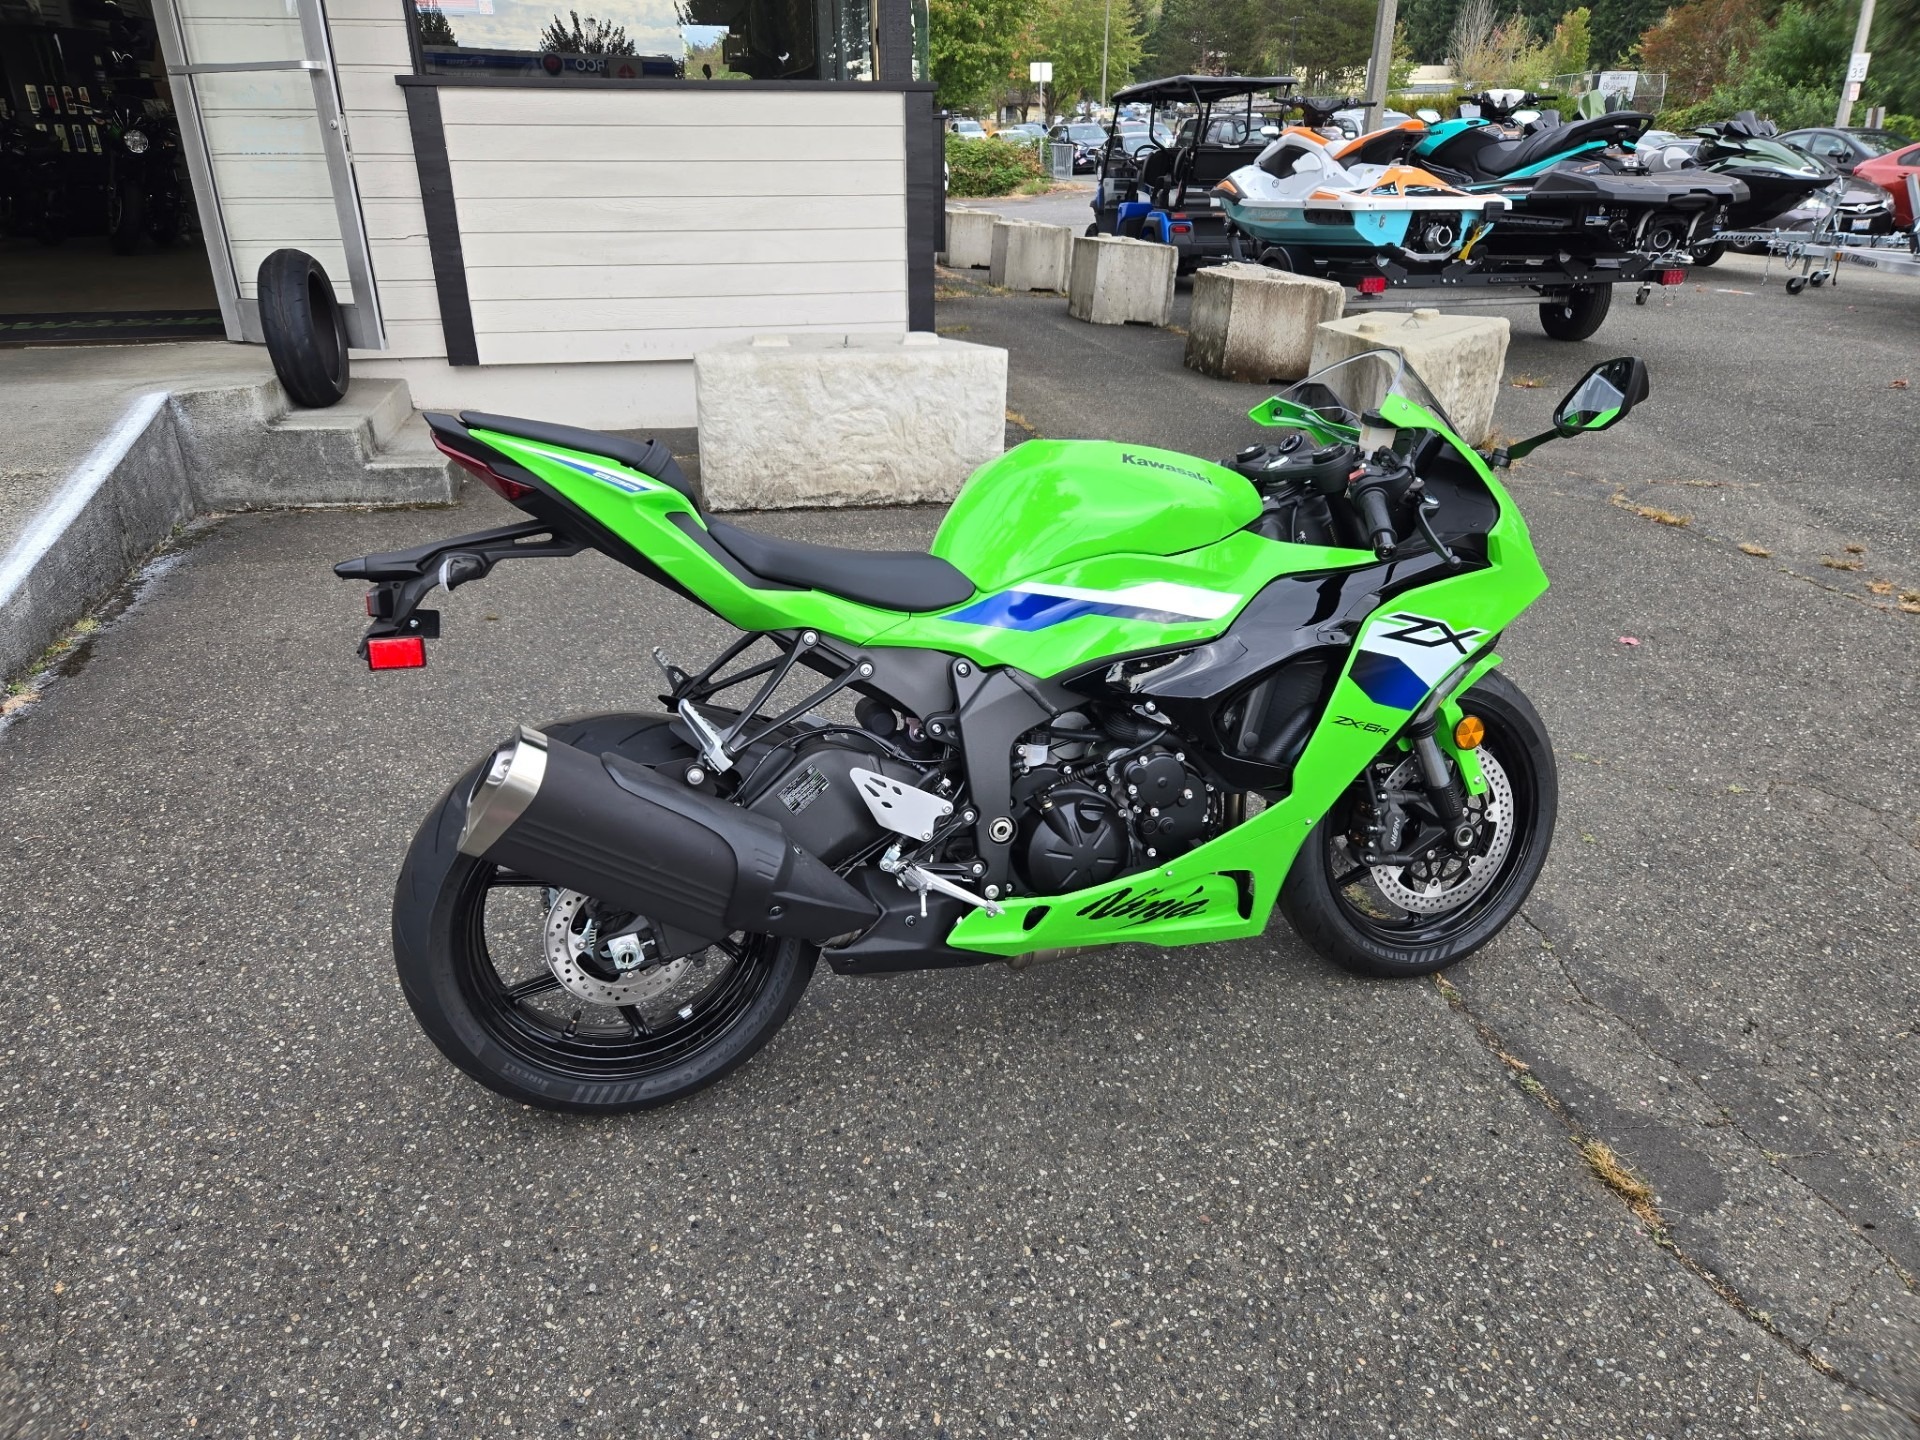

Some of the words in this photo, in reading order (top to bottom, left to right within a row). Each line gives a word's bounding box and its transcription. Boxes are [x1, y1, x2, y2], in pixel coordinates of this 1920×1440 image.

[1850, 67, 1865, 79] 35
[1122, 453, 1213, 486] Kawasaki
[1378, 613, 1483, 655] ZX
[1331, 715, 1390, 736] ZX-6R
[1076, 885, 1210, 930] Ninja
[1362, 940, 1408, 962] DIABLO
[503, 1061, 550, 1092] PIRELLI
